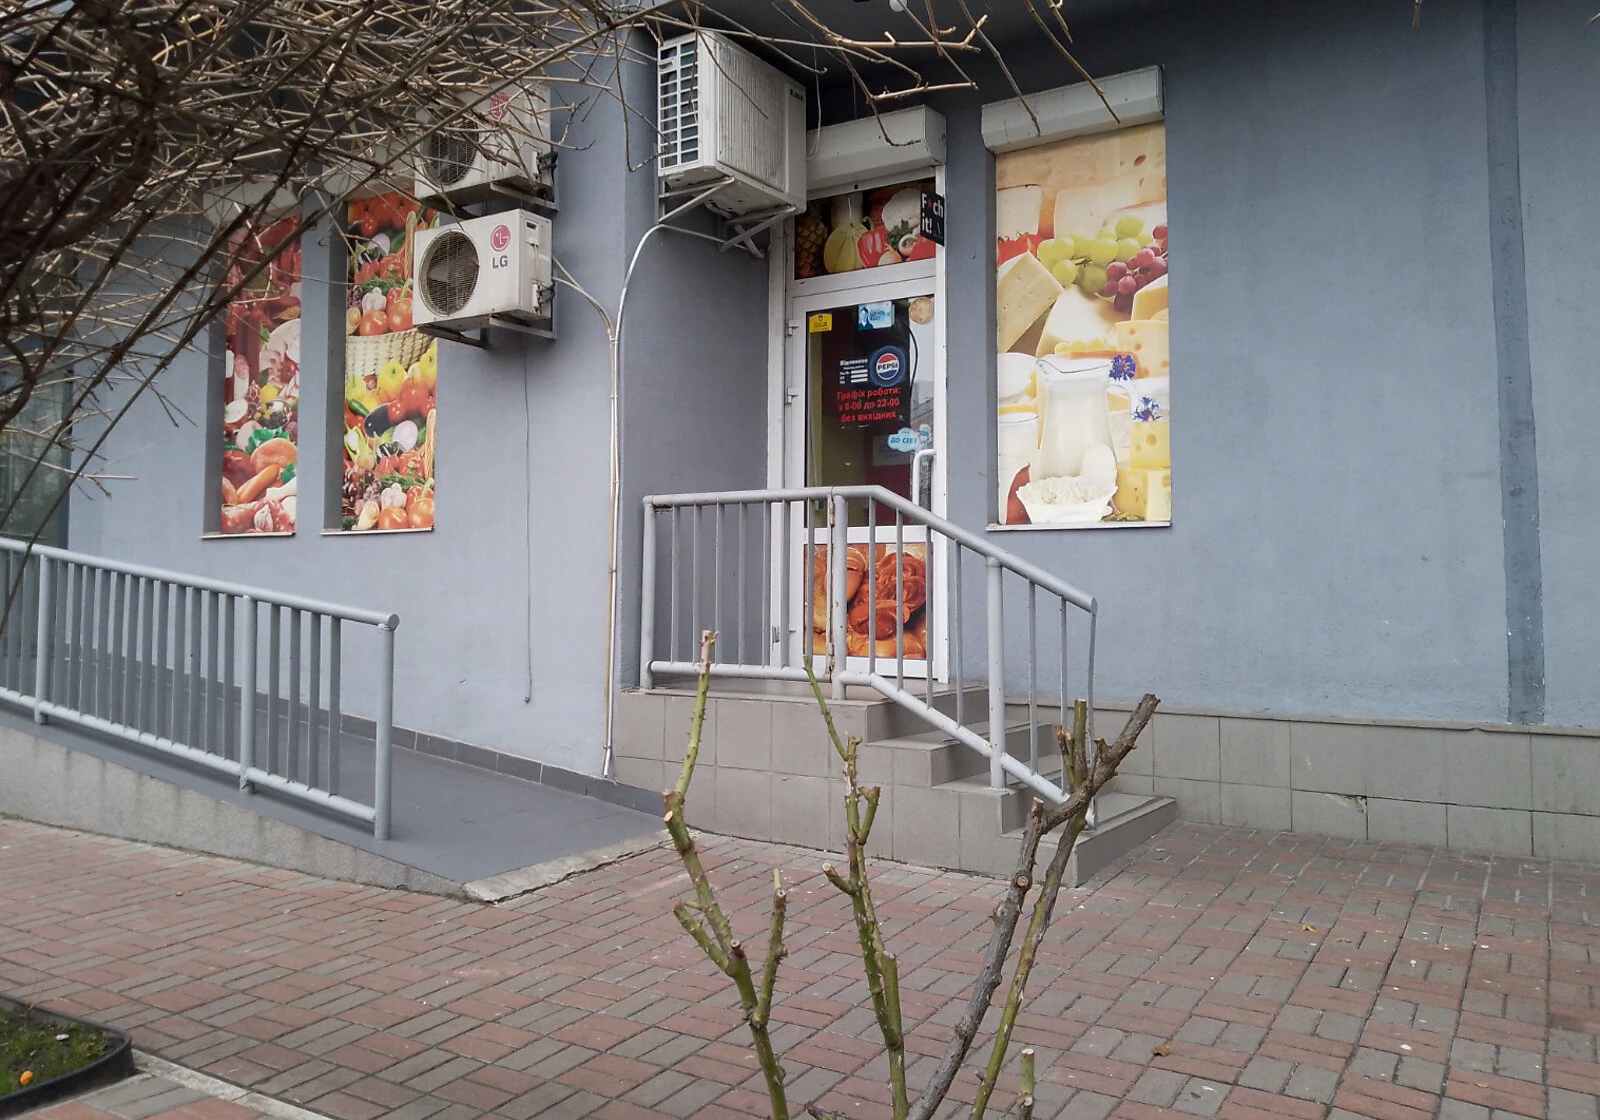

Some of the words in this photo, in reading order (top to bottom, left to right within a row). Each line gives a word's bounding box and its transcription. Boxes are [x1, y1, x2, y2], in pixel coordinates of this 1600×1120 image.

[492, 256, 508, 269] LG
[837, 390, 865, 400] Графік
[863, 401, 874, 409] до
[877, 398, 899, 407] 22-00
[841, 414, 855, 422] без
[857, 412, 896, 420] вихідних
